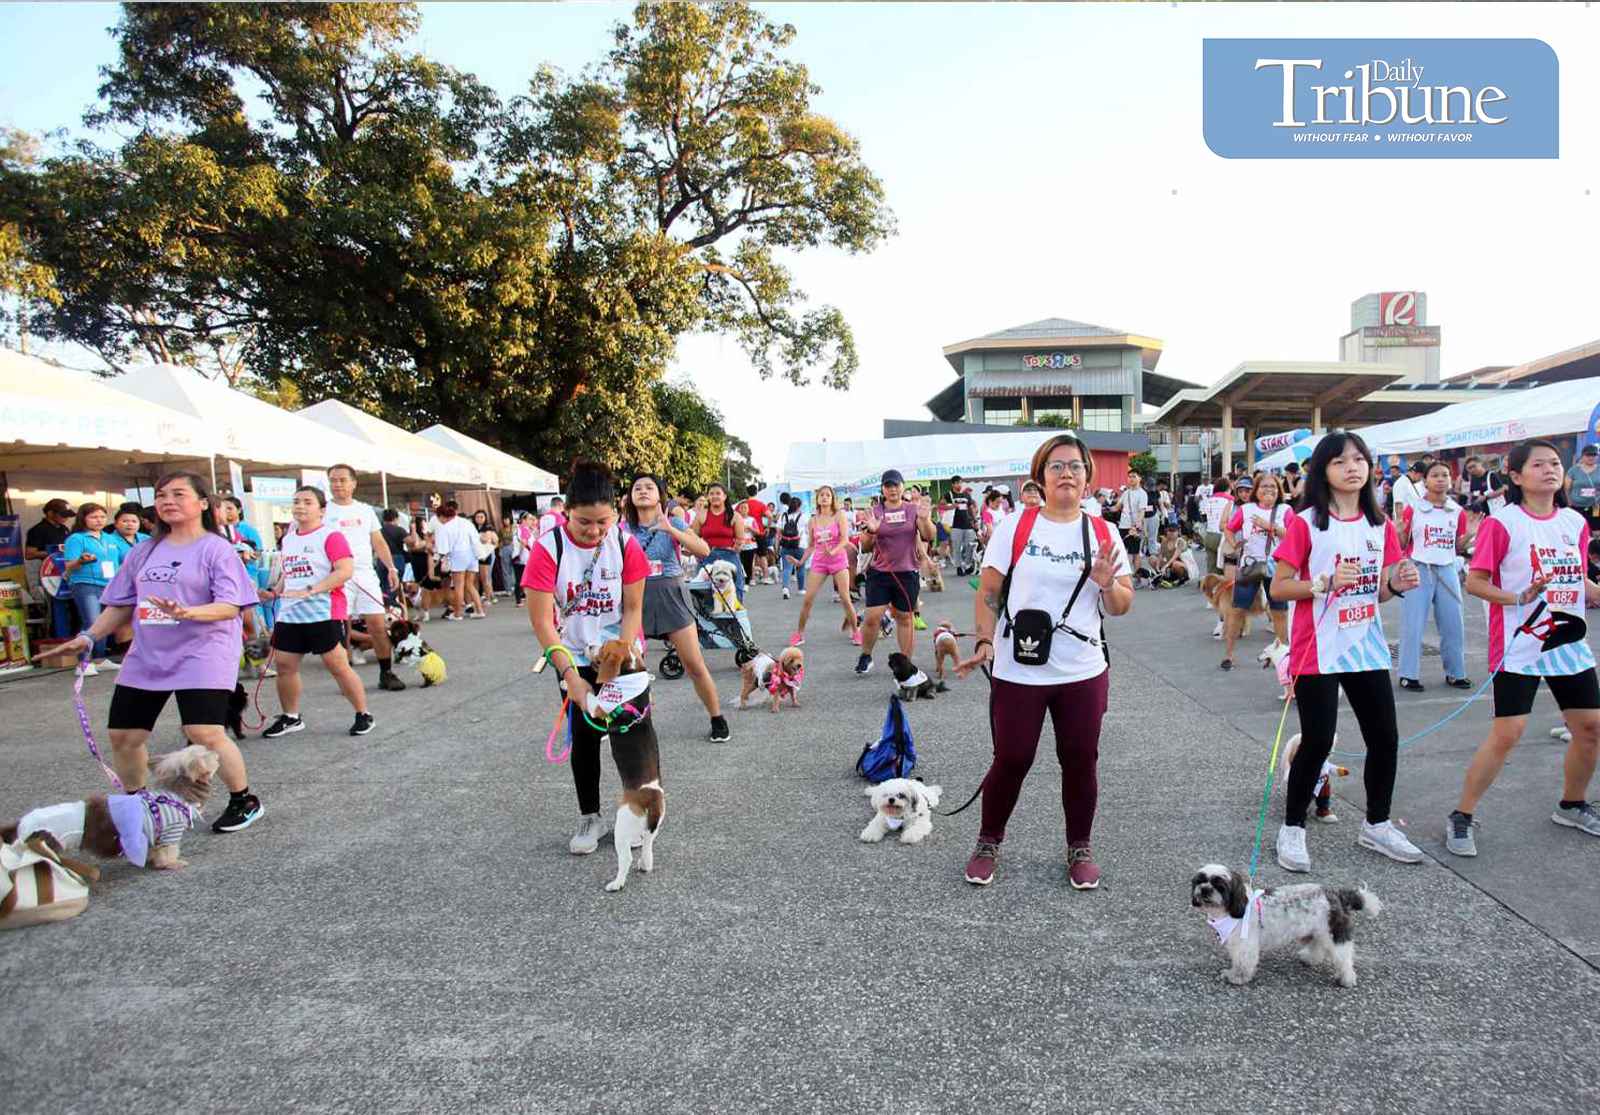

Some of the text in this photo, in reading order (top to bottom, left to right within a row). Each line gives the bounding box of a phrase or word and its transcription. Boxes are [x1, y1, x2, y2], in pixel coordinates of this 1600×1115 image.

[1259, 434, 1289, 450] START
[917, 464, 985, 476] METROMART
[1539, 548, 1556, 558] PET
[1552, 565, 1582, 575] WALK
[1553, 591, 1573, 603] 082
[1346, 606, 1369, 619] 081
